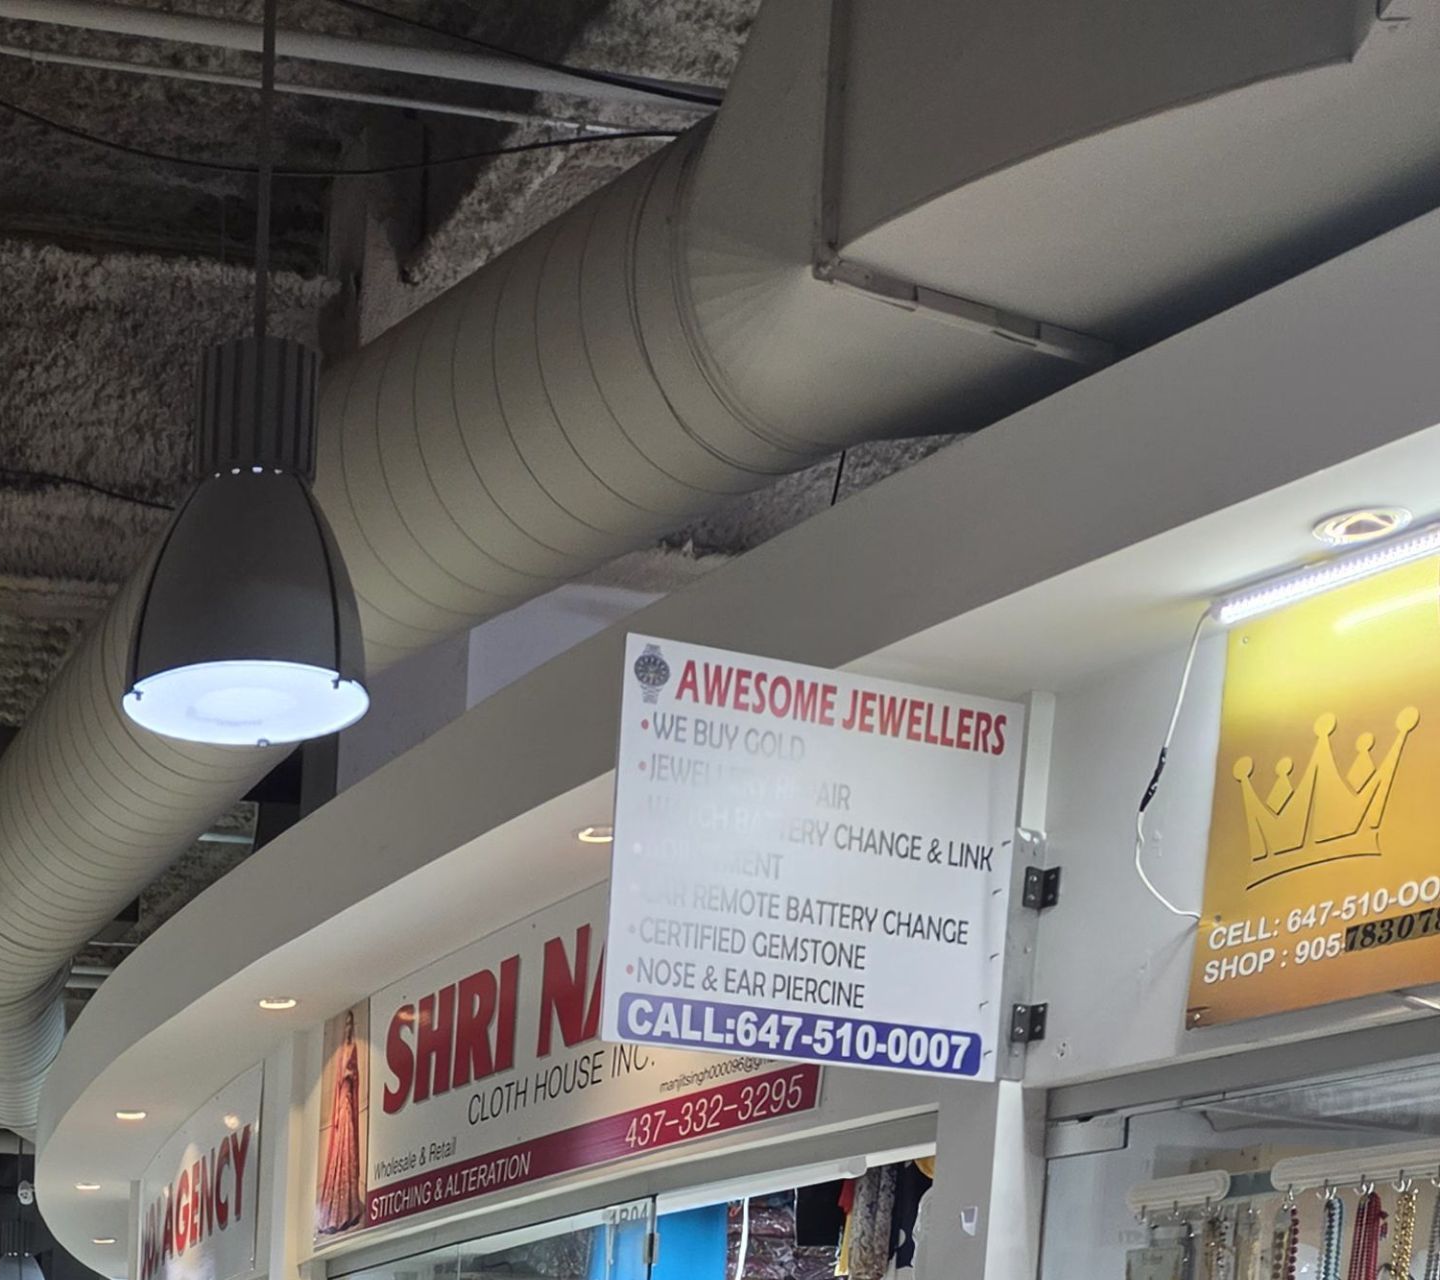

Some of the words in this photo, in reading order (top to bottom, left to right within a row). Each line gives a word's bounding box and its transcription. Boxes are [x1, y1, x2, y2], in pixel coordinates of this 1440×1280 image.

[653, 711, 687, 743] WE
[693, 718, 739, 751] BUY
[744, 728, 806, 762] GOLD
[675, 659, 838, 726] AWESOME
[841, 688, 1007, 756] JEWELLERS
[834, 824, 921, 862] CHANGE
[927, 838, 943, 863] &
[948, 841, 994, 872] LINK
[639, 917, 745, 955] CERTIFIED
[753, 933, 866, 970] GEMSTONE
[694, 884, 780, 920] REMOTE
[786, 895, 878, 932] BATTERY
[883, 909, 969, 945] CHANGE
[1209, 916, 1281, 950] CELL:
[1287, 876, 1440, 932] 647-510-00
[636, 958, 696, 991] NOSE
[702, 966, 717, 991] &
[724, 968, 765, 997] EAR
[1203, 948, 1275, 984] SHOP
[383, 953, 521, 1115] SHRI
[627, 999, 972, 1070] CALL:647-510-0007
[468, 1077, 527, 1127] CLOTH
[534, 1062, 604, 1105] HOUSE
[611, 1045, 656, 1079] INC.
[624, 1073, 804, 1149] 437-332-3295
[370, 1181, 432, 1220] STITCHING
[434, 1177, 443, 1201] &
[444, 1151, 532, 1199] ALTERATION
[374, 1152, 417, 1181] Wholesale
[419, 1147, 426, 1166] &
[429, 1136, 457, 1163] Retail
[161, 1123, 252, 1267] AGENCY
